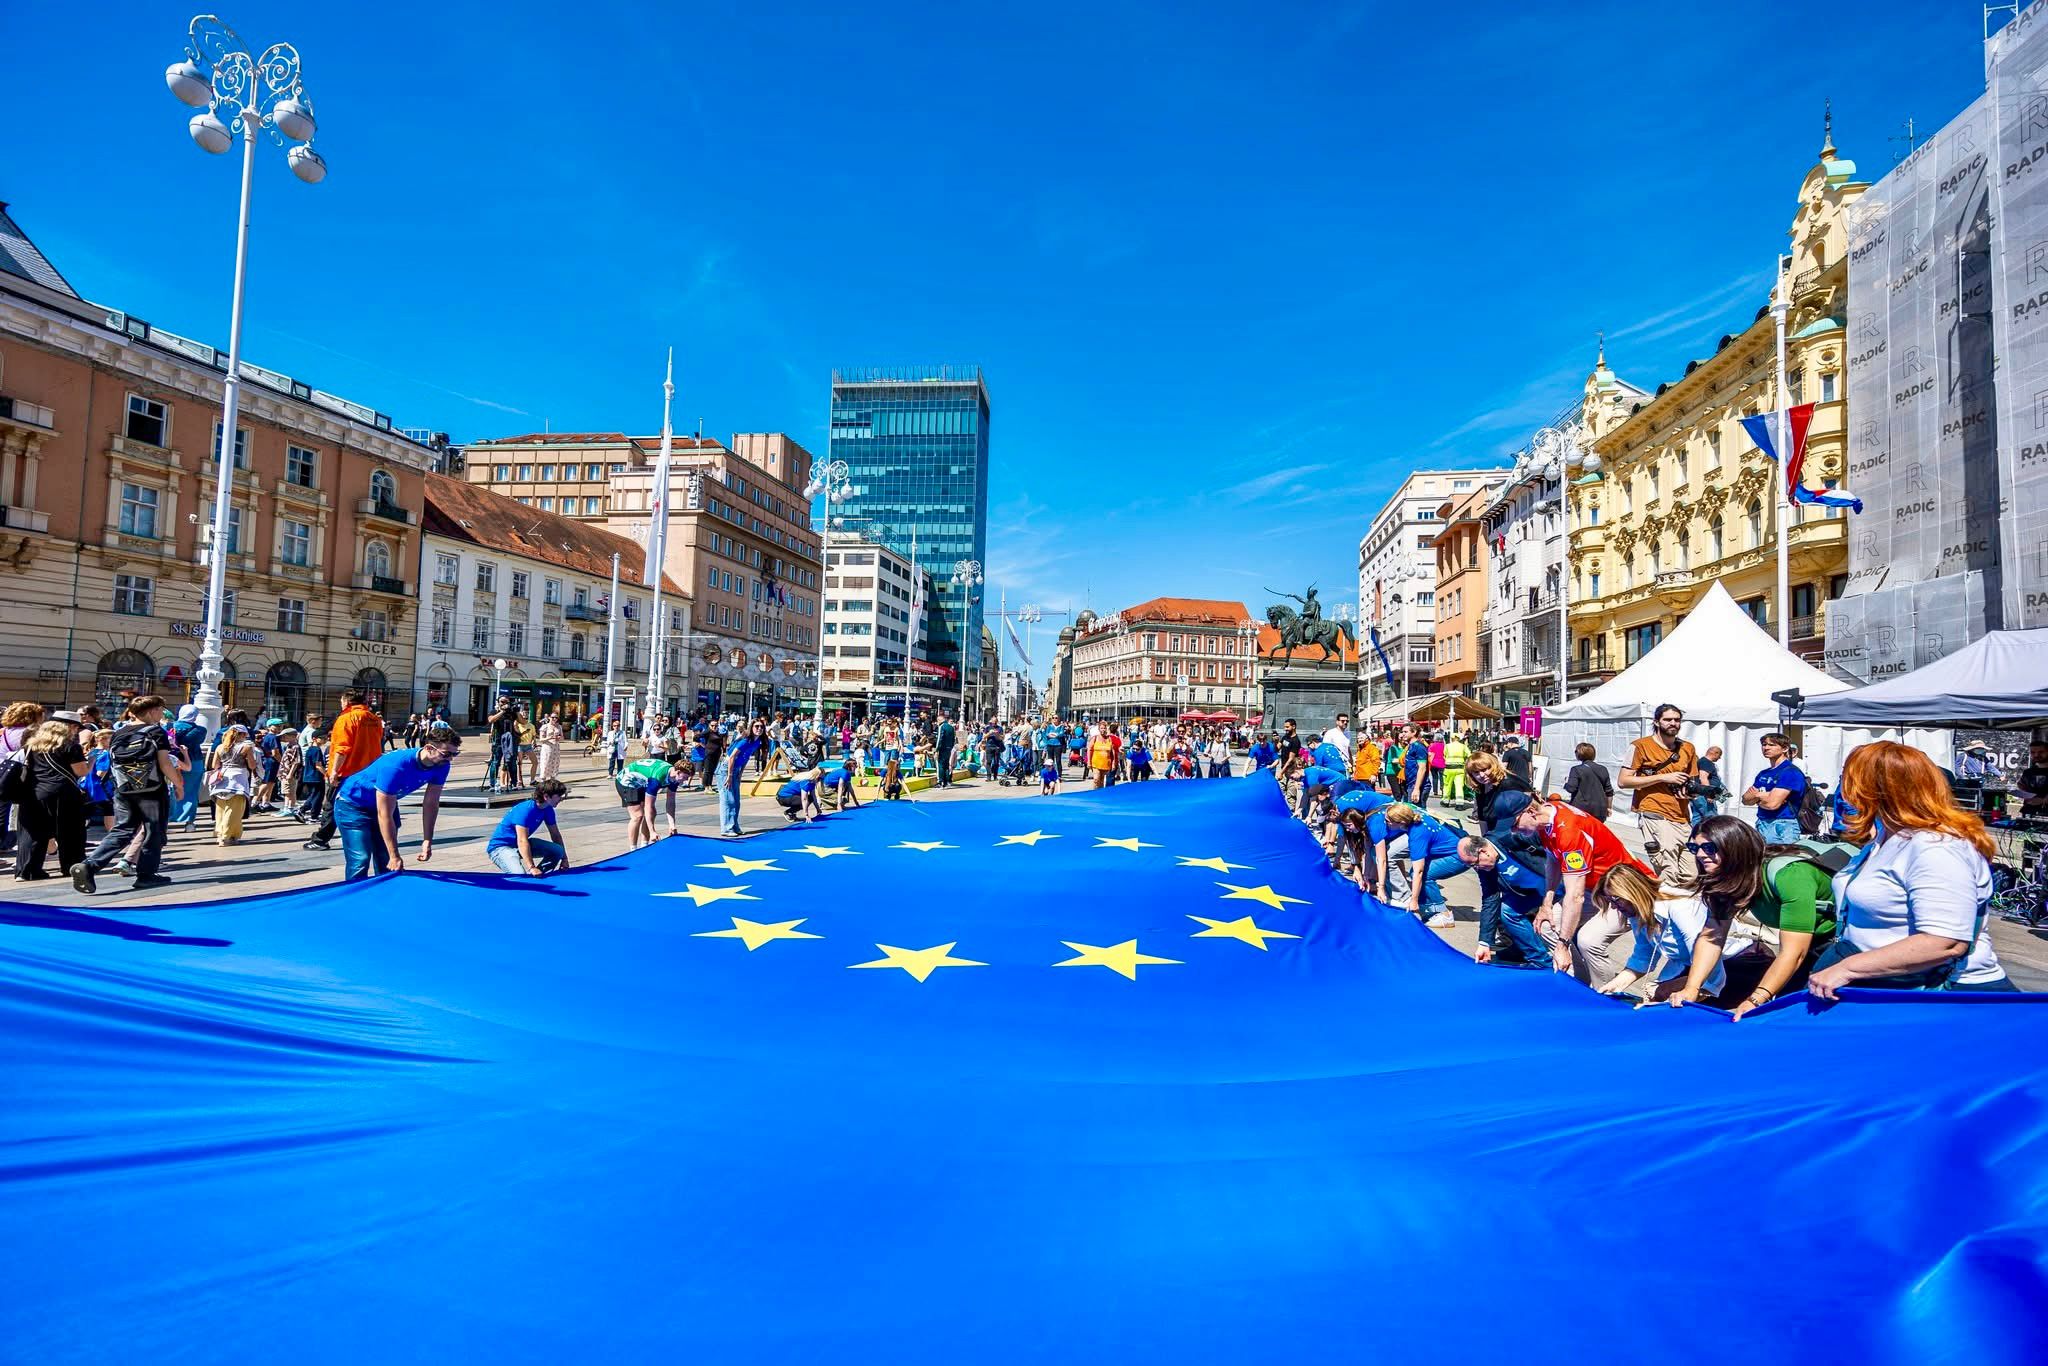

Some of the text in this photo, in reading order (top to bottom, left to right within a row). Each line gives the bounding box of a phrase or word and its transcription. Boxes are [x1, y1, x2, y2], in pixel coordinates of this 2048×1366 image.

[1939, 153, 1982, 194] RADIĆ
[1852, 229, 1886, 261] RADIĆ
[1850, 340, 1887, 367] RADIĆ
[1895, 376, 1934, 404] RADIĆ
[1943, 408, 1986, 436] RADIĆ
[1850, 451, 1887, 474] RADIĆ
[1896, 498, 1935, 519] RADIĆ
[1943, 537, 1989, 559] RADIĆ
[236, 628, 264, 642] knjiga
[346, 641, 398, 656] SINGER
[1825, 644, 1862, 660] RADIĆ
[1871, 660, 1907, 674] RADIĆ
